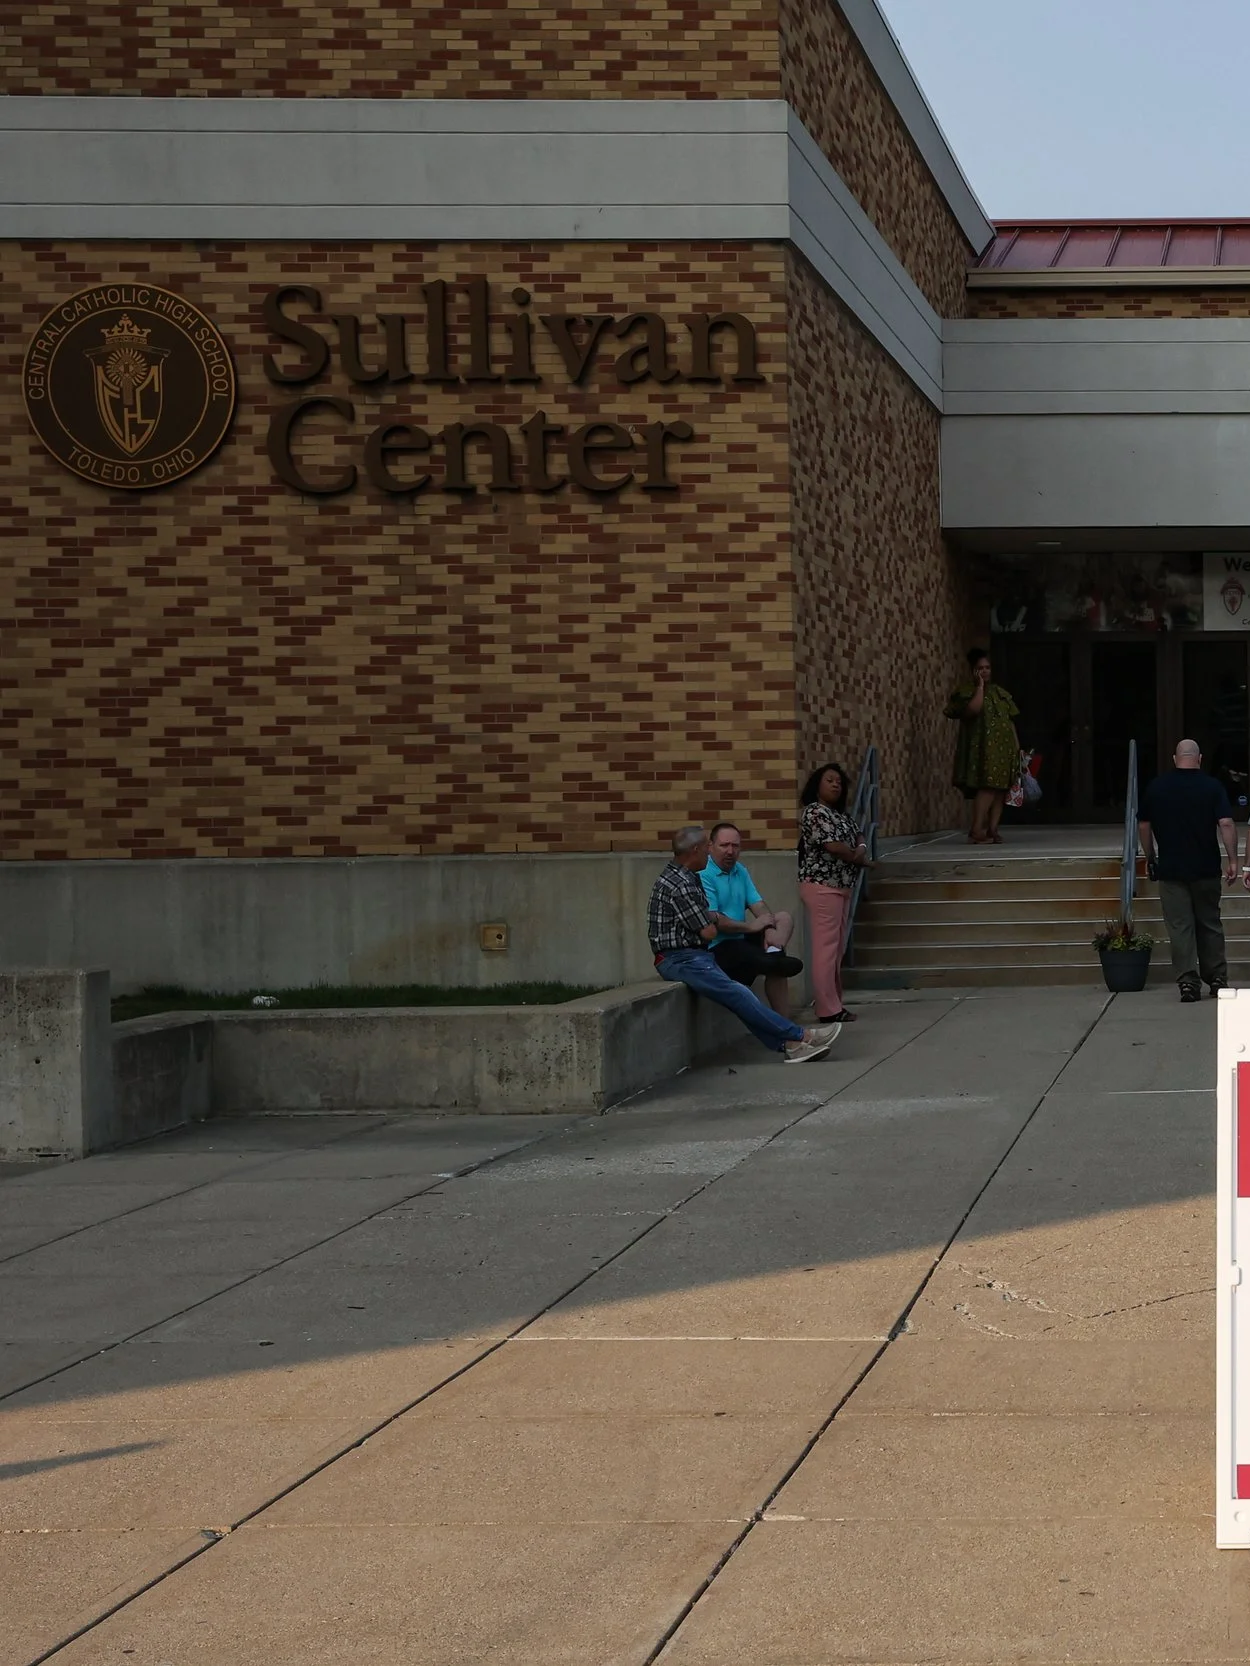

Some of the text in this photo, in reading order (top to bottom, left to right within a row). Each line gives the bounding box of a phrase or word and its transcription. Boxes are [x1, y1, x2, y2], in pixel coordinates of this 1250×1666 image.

[28, 287, 230, 402] CENTRAL CATHOLIC HIGH SCHOOL
[263, 279, 766, 385] Sullivan
[67, 446, 196, 483] TOLEDO, OHIO
[266, 394, 695, 496] Center
